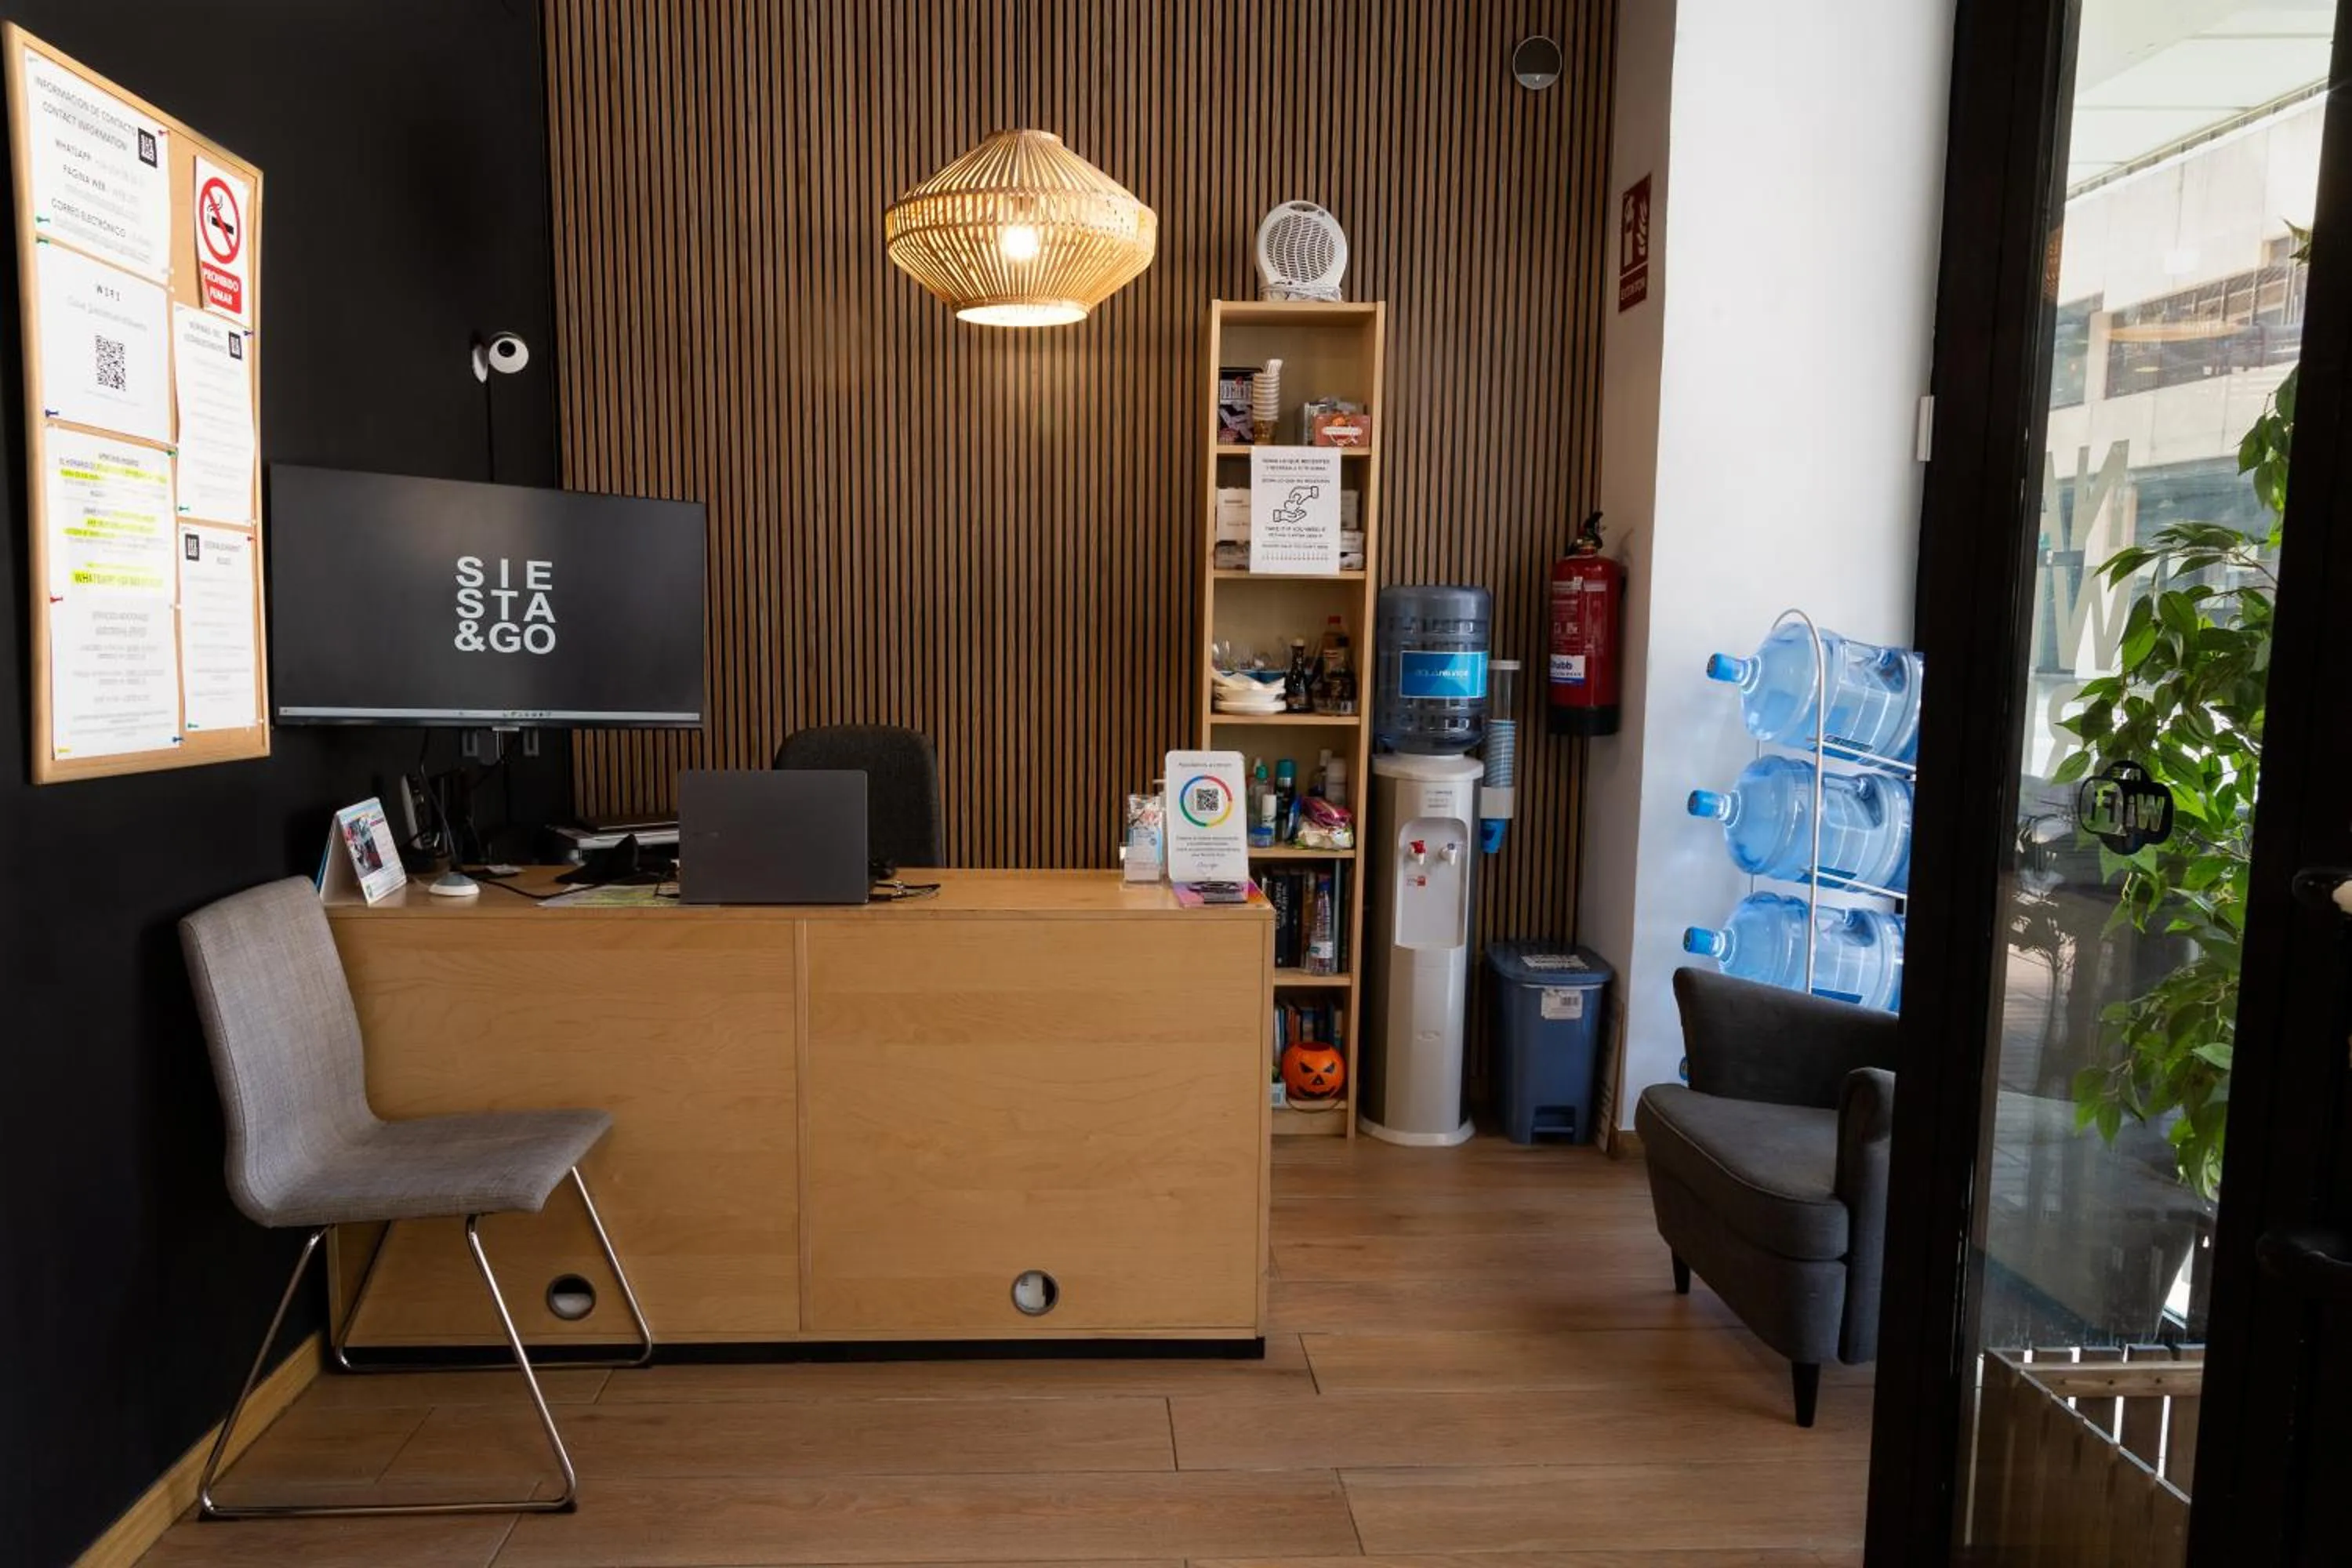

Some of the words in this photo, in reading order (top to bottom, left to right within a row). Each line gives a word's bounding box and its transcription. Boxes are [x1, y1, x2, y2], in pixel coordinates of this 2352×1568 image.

[42, 101, 77, 125] CONTACT
[78, 118, 128, 151] INFORMATION
[101, 111, 136, 136] CONTACTO
[456, 556, 553, 590] SIE
[456, 588, 556, 623] STA
[454, 619, 556, 655] &GO
